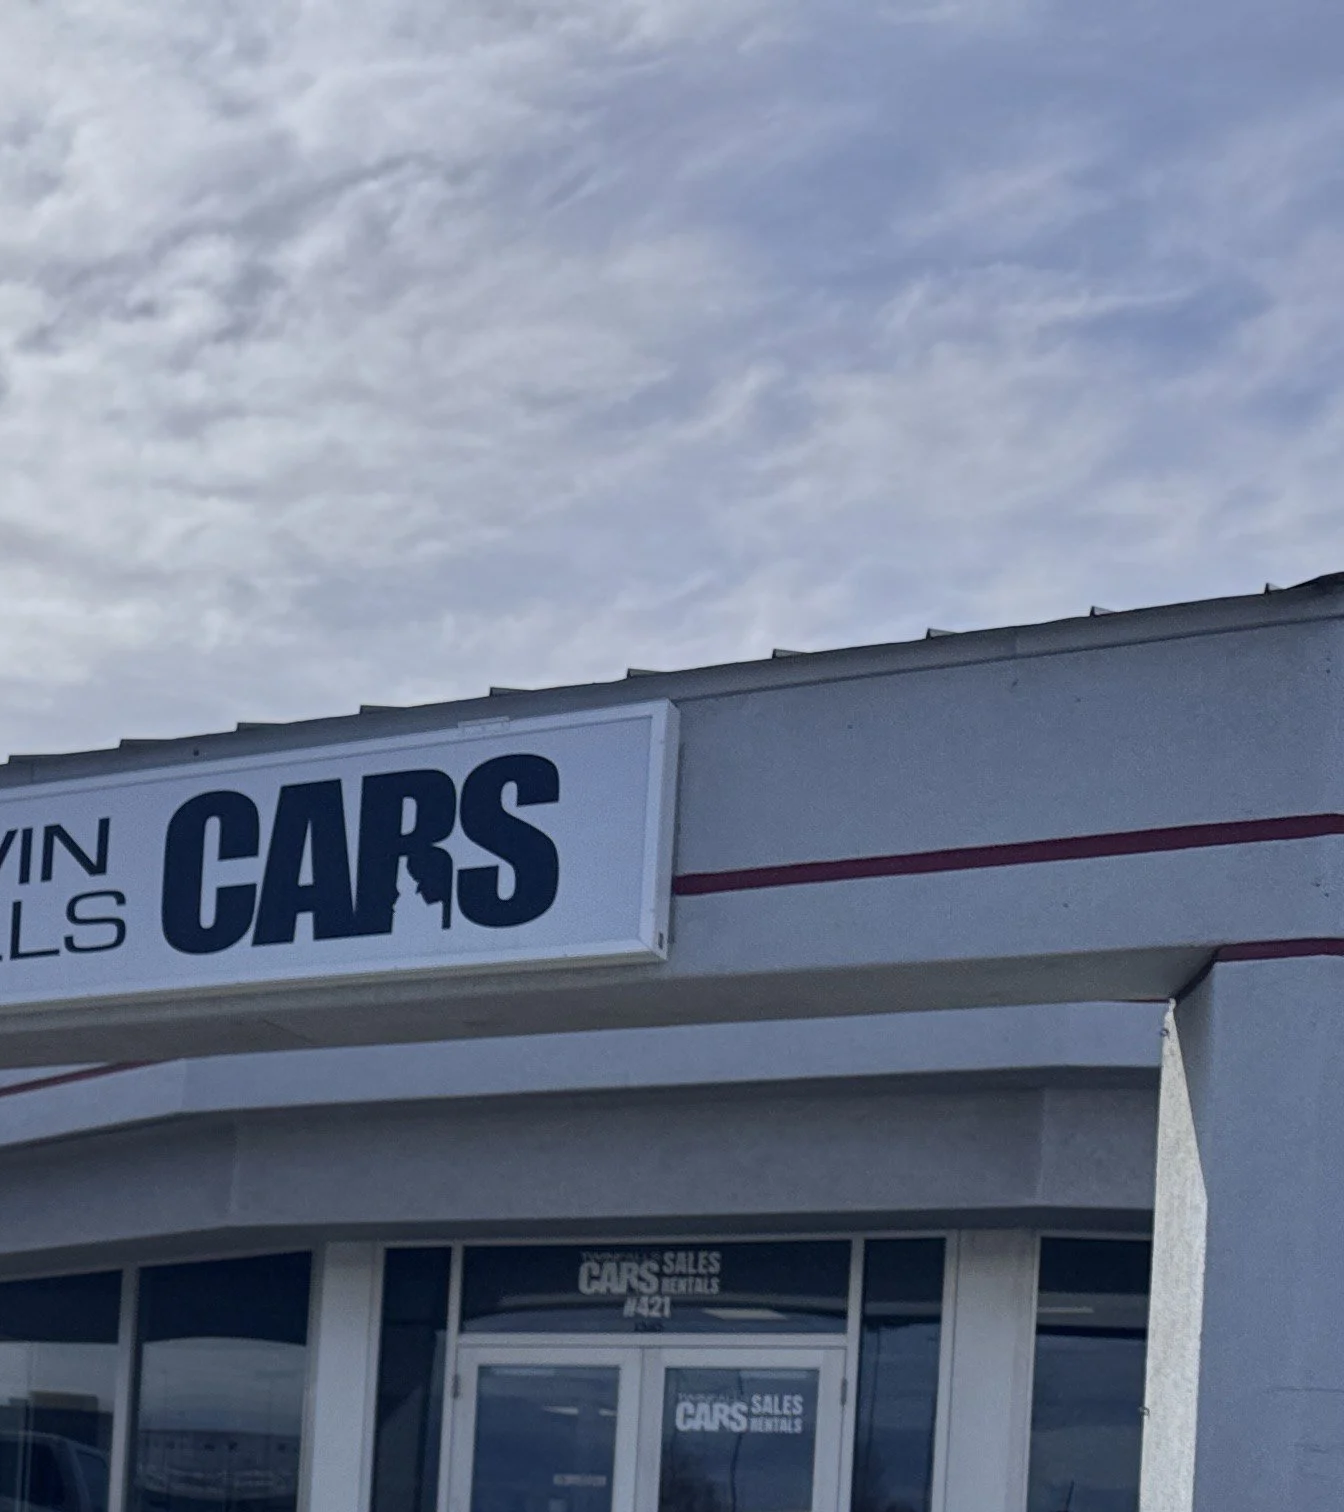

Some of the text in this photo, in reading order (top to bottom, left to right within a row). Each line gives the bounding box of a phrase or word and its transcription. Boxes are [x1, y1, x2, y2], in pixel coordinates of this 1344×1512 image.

[161, 753, 560, 954] CARS
[662, 1251, 721, 1275] SALES
[578, 1261, 660, 1296] CARS
[622, 1295, 671, 1318] #421
[675, 1401, 748, 1432] CARS
[751, 1394, 804, 1415] SALES
